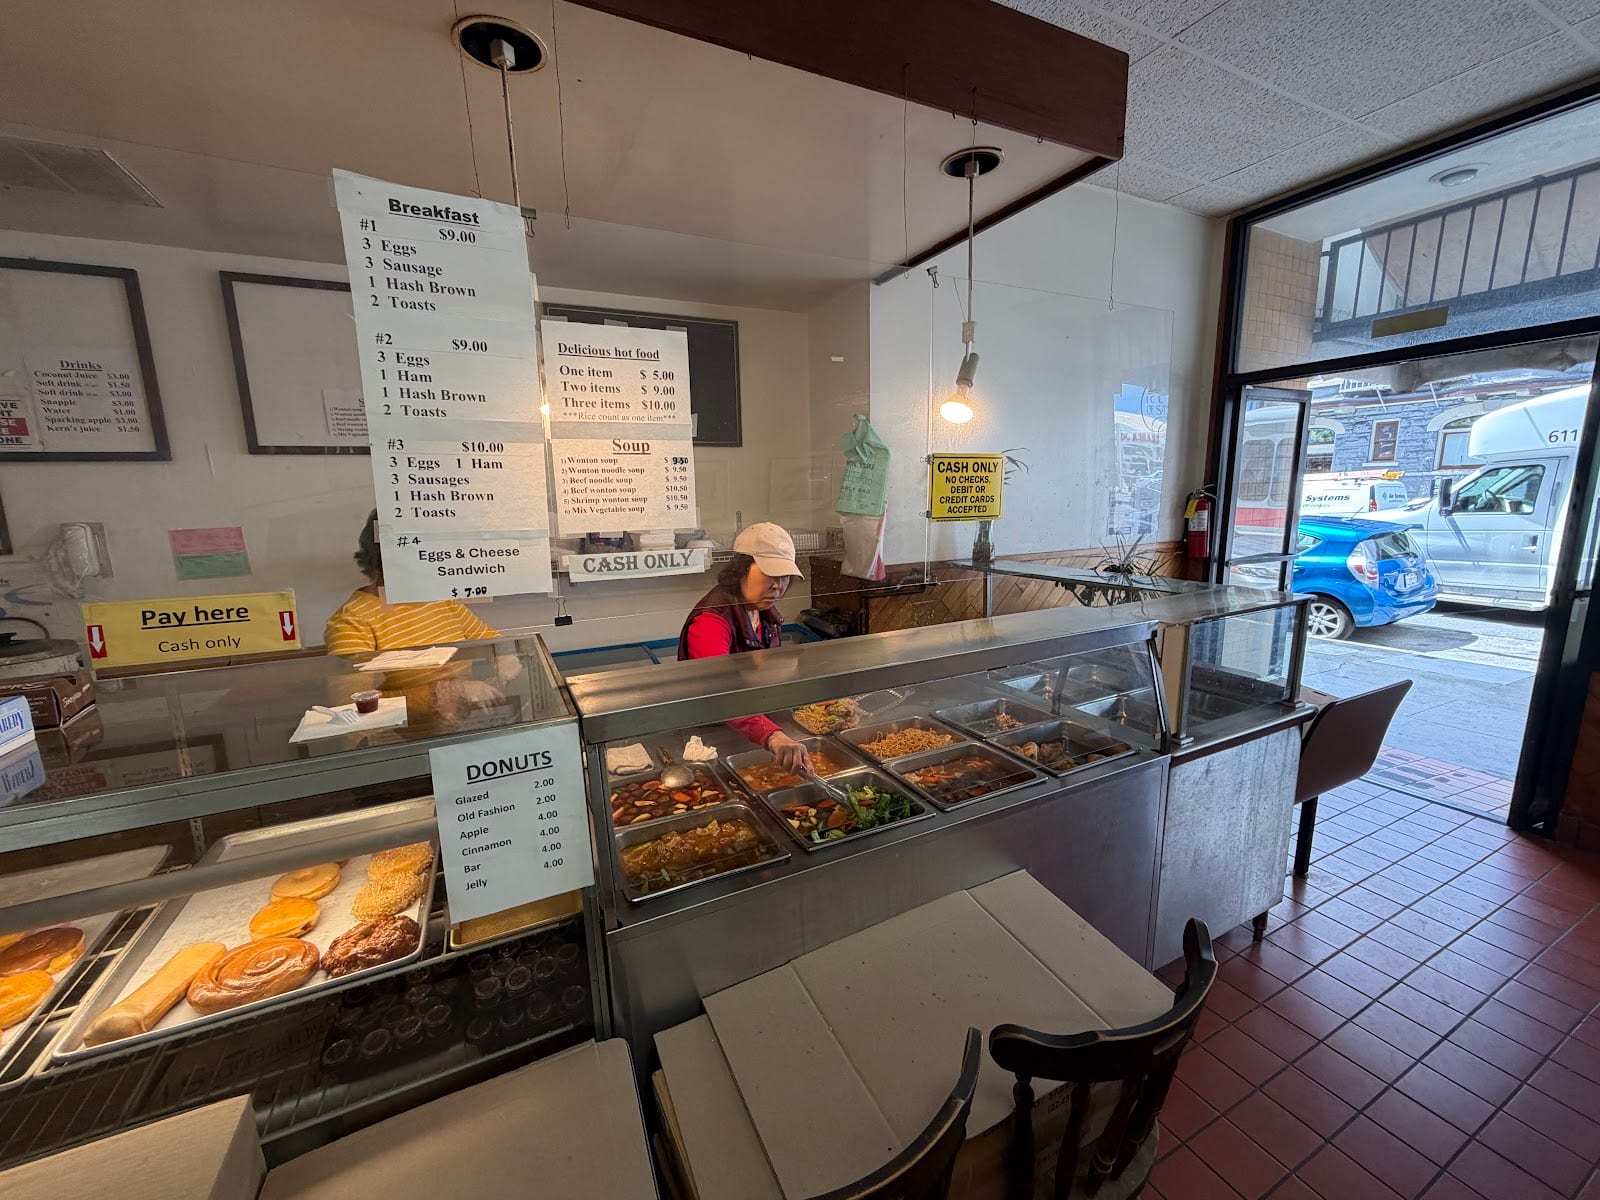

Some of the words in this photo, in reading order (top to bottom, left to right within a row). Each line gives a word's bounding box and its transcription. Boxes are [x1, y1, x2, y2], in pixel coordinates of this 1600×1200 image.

[388, 198, 480, 224] Breakfast
[360, 218, 376, 231] #1
[439, 228, 476, 243] $9.00
[362, 238, 371, 249] 3
[381, 240, 417, 257] Eggs
[365, 257, 373, 268] 3
[383, 259, 443, 278] Sausage
[369, 276, 375, 287] 1
[386, 277, 424, 292] Hash
[429, 281, 476, 296] Brown
[371, 295, 379, 306] 2
[388, 296, 436, 311] Toasts
[376, 333, 392, 345] #2
[451, 339, 488, 352] $9.00
[558, 342, 611, 357] Delicious
[614, 347, 632, 358] hot
[636, 349, 659, 359] food
[60, 360, 102, 369] Drinks
[378, 351, 385, 362] 3
[395, 353, 430, 367] Eggs
[381, 370, 386, 379] 1
[398, 371, 432, 383] Ham
[560, 365, 584, 376] One
[588, 367, 612, 378] item
[640, 370, 646, 380] $
[653, 371, 674, 380] 5.00
[383, 387, 388, 397] 1
[400, 388, 435, 400] Hash
[441, 389, 486, 402] Brown
[560, 381, 586, 392] Two
[591, 382, 621, 393] items
[641, 385, 647, 395] $
[654, 386, 675, 395] 9.00
[383, 405, 391, 416] 2
[400, 405, 447, 417] Toasts
[562, 397, 596, 408] Three
[601, 399, 630, 409] items
[642, 401, 675, 410] $10.00
[599, 413, 619, 421] count
[1549, 429, 1578, 443] 611
[387, 439, 404, 450] #3
[462, 442, 503, 452] $10.00
[612, 438, 650, 453] Soup
[390, 457, 398, 467] 3
[407, 457, 440, 470] Eggs
[456, 458, 462, 468] 1
[472, 459, 503, 469] Ham
[938, 462, 968, 473] CASH
[972, 462, 998, 472] ONLY
[392, 474, 399, 484] 3
[408, 474, 469, 486] Sausages
[959, 476, 991, 484] CHECKS,
[394, 491, 400, 501] 1
[410, 491, 445, 501] Hash
[451, 491, 494, 501] Brown
[940, 496, 968, 504] CREDIT
[1305, 494, 1350, 503] Systems
[394, 508, 402, 518] 2
[411, 507, 456, 518] Toasts
[419, 550, 451, 562] Eggs
[456, 549, 465, 558] &
[469, 548, 519, 558] Cheese
[583, 556, 638, 573] CASH
[644, 550, 694, 568] ONLY
[438, 564, 505, 576] Sandwich
[452, 588, 457, 597] $
[141, 609, 186, 627] Pay
[195, 606, 248, 622] here
[158, 639, 199, 653] Cash
[205, 635, 241, 649] only
[466, 750, 552, 780] DONUTS
[455, 791, 489, 805] Glazed
[534, 778, 554, 788] 2.00
[457, 812, 475, 822] Old
[478, 804, 515, 818] Fashion
[536, 794, 556, 805] 2.00
[460, 827, 489, 840] Apple
[538, 810, 558, 821] 4.00
[462, 839, 512, 856] Cinnamon
[540, 826, 560, 837] 4.00
[464, 863, 481, 873] Bar
[542, 842, 561, 852] 4.00
[466, 879, 488, 890] Jelly
[544, 858, 563, 868] 4.00
